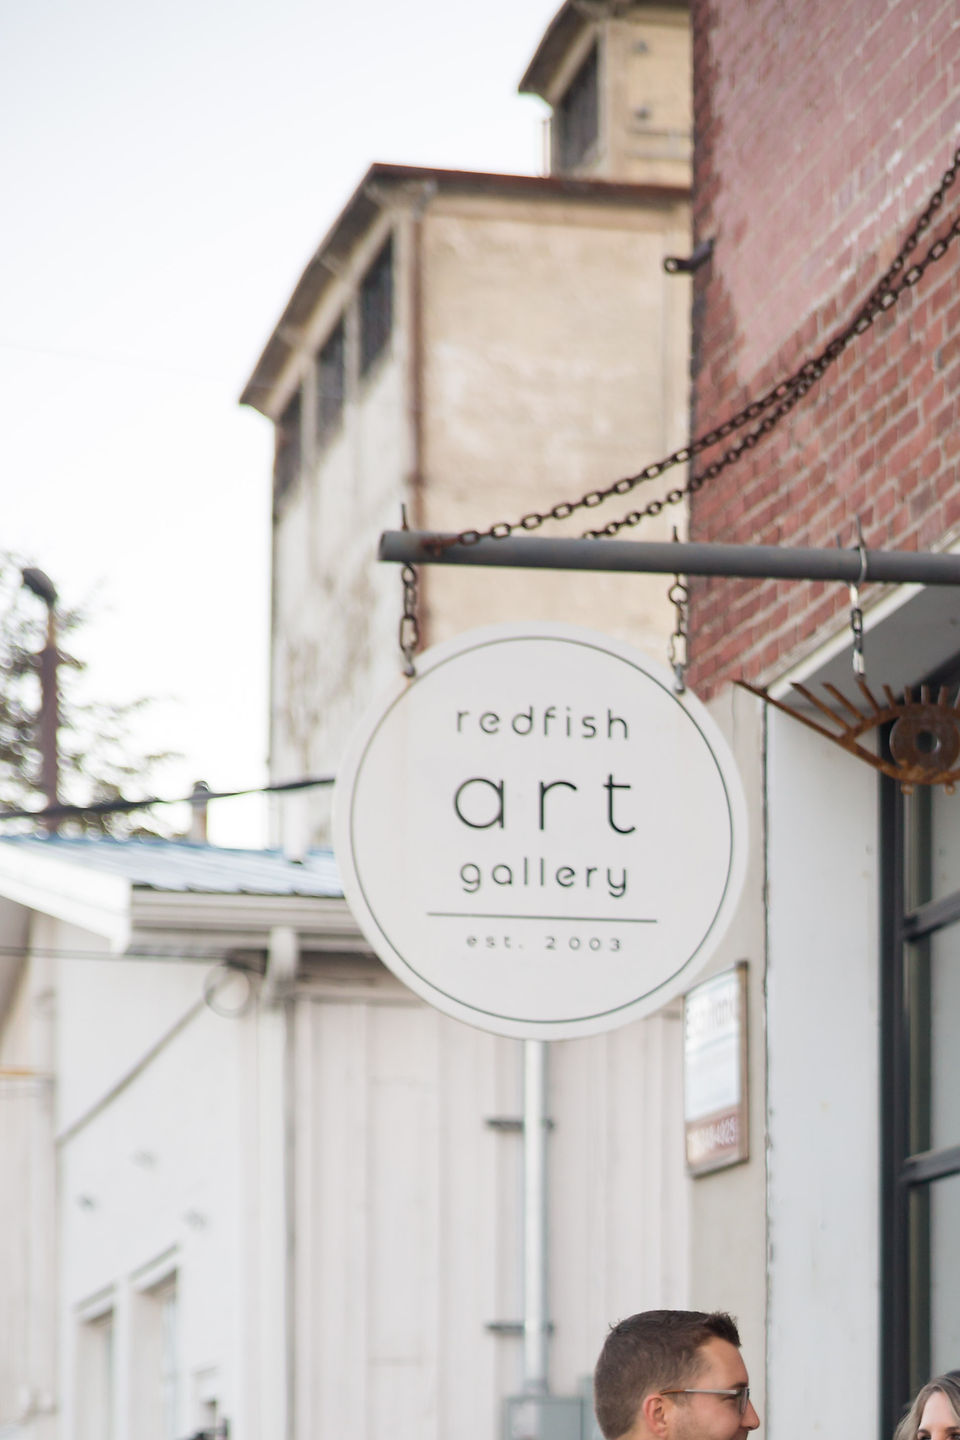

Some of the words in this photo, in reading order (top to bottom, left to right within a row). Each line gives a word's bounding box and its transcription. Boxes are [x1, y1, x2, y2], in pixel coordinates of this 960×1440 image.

[456, 705, 630, 740] redfish
[453, 773, 636, 836] art
[459, 857, 629, 899] gallery
[465, 935, 524, 951] est.
[545, 935, 622, 952] 2003
